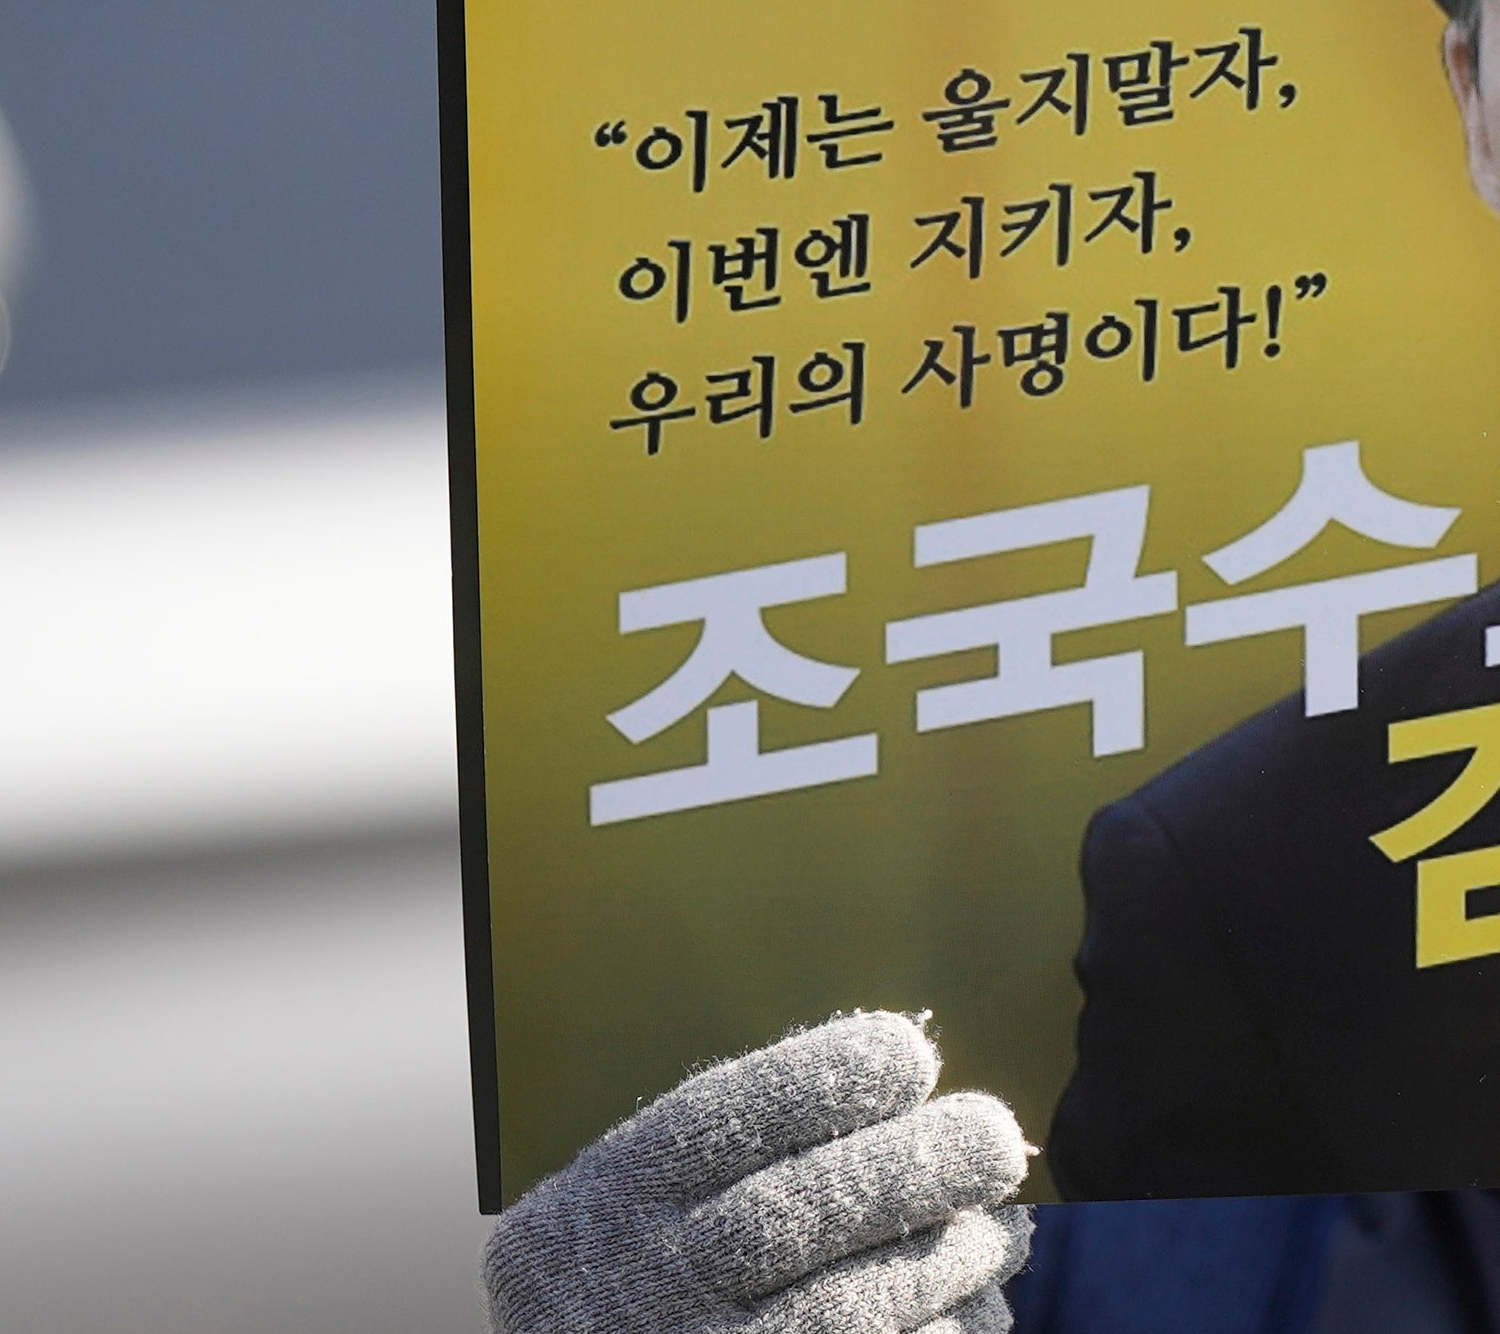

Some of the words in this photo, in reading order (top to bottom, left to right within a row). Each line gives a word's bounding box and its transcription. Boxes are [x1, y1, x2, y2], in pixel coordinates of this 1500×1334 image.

[593, 93, 896, 194] “이제는
[921, 27, 1298, 155] 울지말자,
[618, 211, 872, 325] 이번엔
[909, 170, 1192, 281] 지키자,
[608, 341, 866, 457] 우리의
[900, 271, 1328, 411] 사명이다!”
